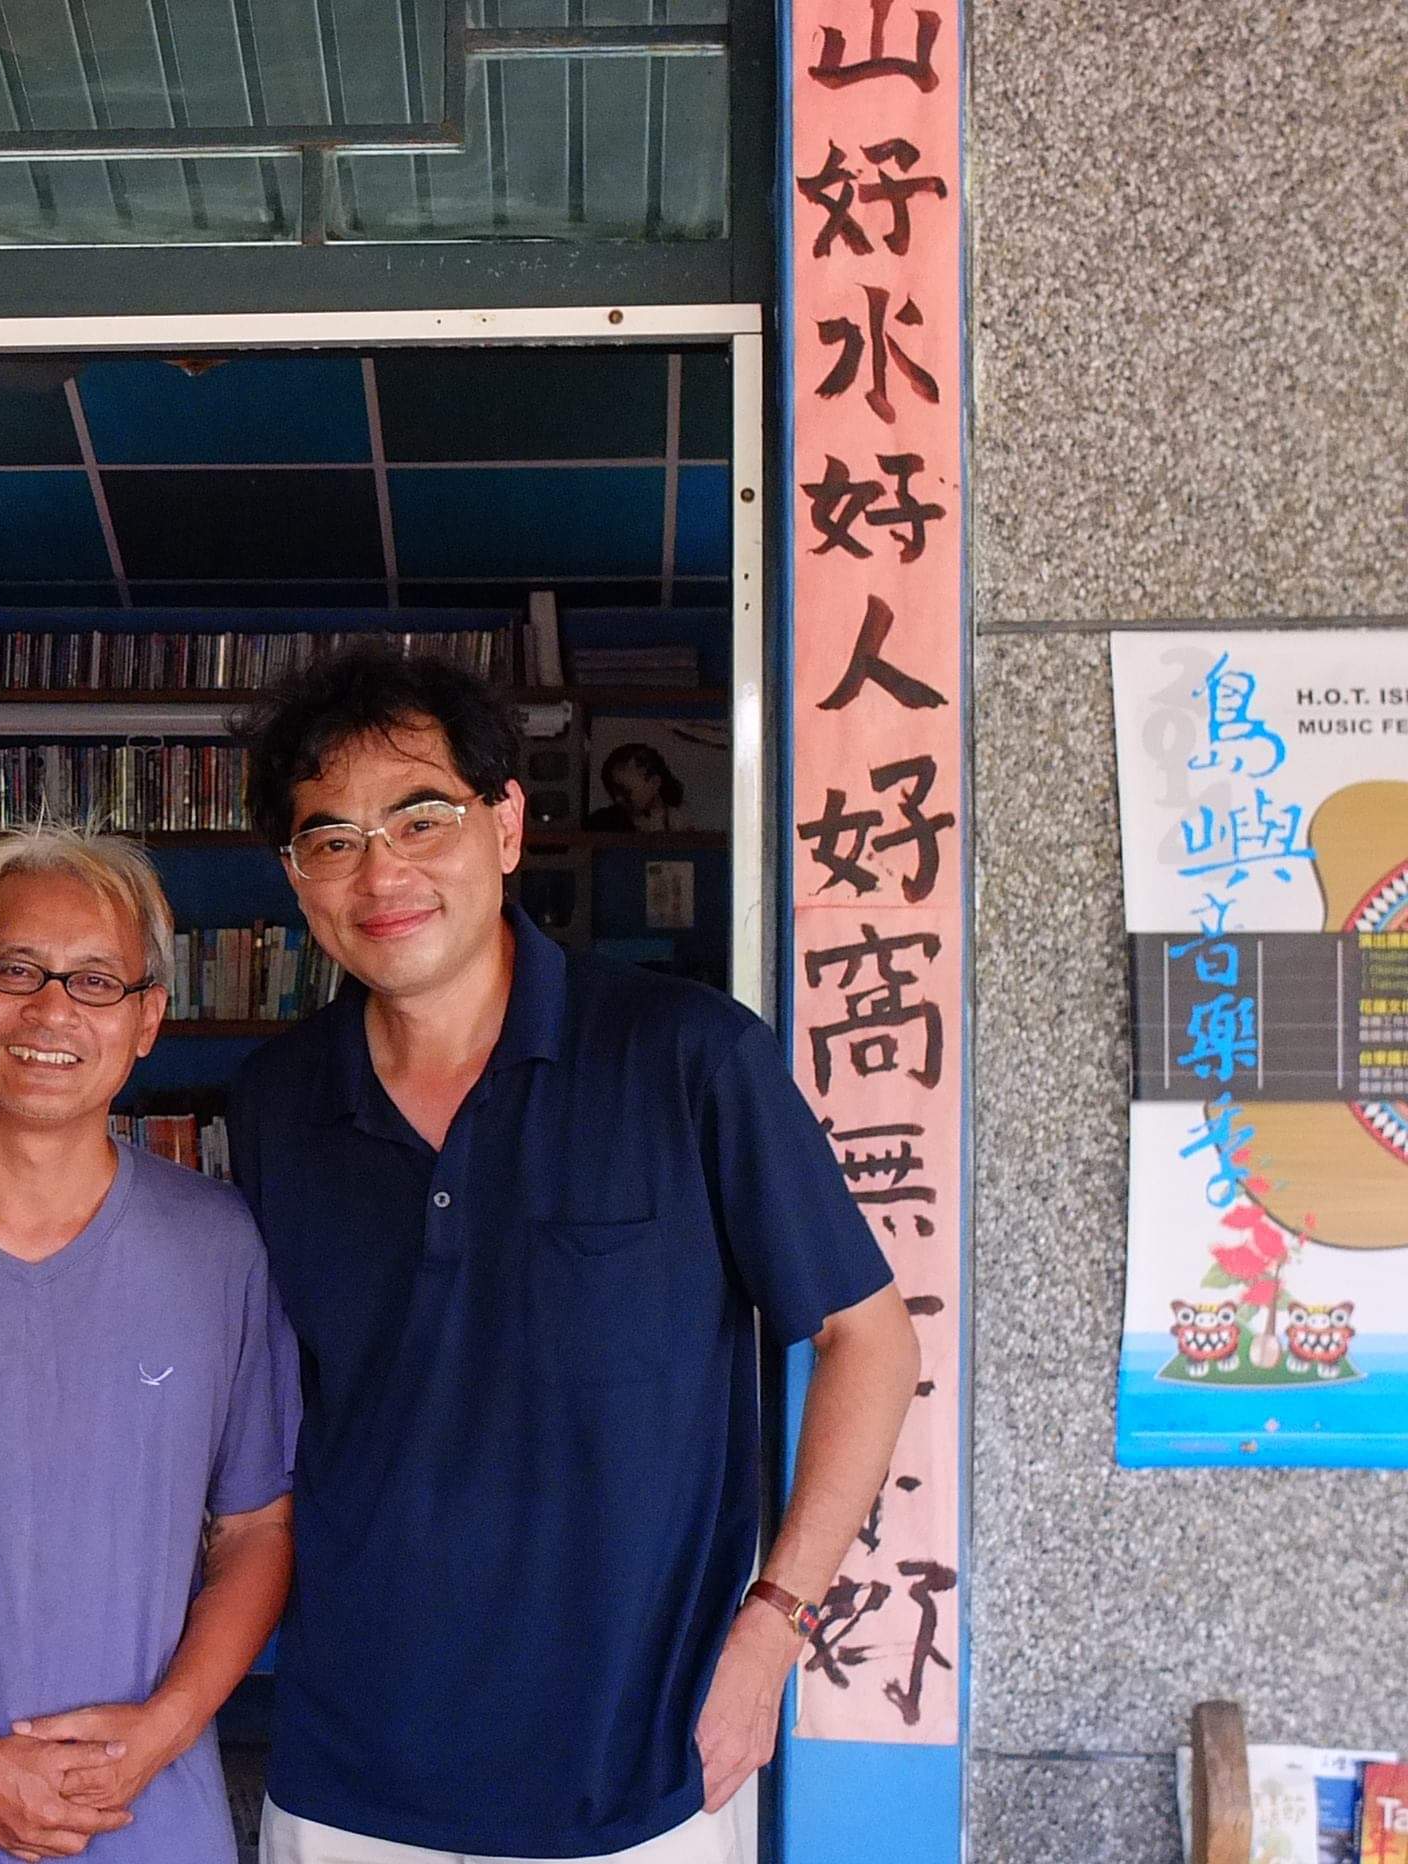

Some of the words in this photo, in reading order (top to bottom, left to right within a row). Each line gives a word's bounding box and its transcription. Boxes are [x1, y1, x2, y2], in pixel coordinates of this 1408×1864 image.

[1297, 687, 1370, 705] H.O.T.
[1380, 687, 1408, 705] IS
[1298, 718, 1373, 734] MUSIC
